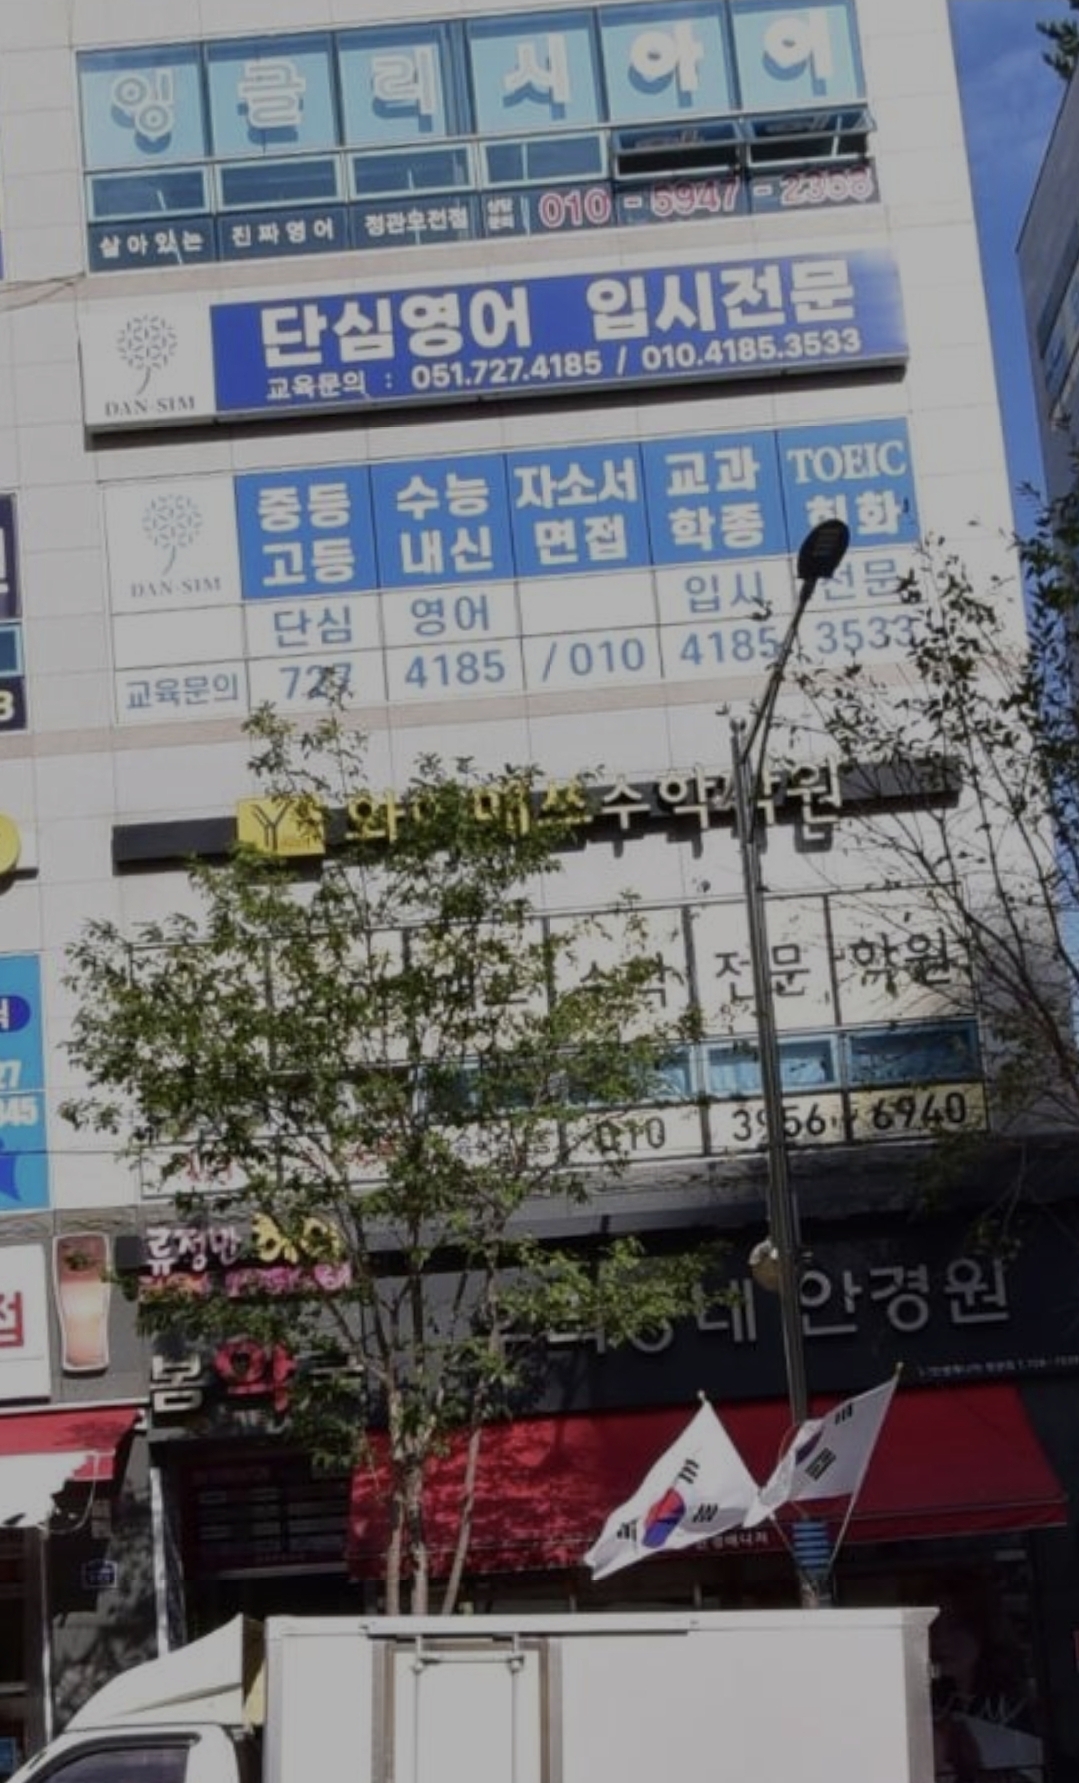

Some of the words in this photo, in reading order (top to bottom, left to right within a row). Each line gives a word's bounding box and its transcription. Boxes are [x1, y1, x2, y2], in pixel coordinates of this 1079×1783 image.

[100, 229, 203, 259] 살아있는
[231, 218, 334, 248] 진짜영어
[538, 187, 612, 228] 010
[260, 286, 532, 368] 단심영어
[586, 259, 855, 341] 입시전문
[266, 369, 367, 400] 교육문의
[410, 350, 603, 391] 051.727.4185
[641, 327, 862, 371] 010.4185.3533
[257, 482, 352, 533] 중등
[396, 473, 490, 520] 수능
[513, 457, 639, 510] 자소서
[664, 446, 759, 497] 교과
[787, 440, 907, 484] TOEIC
[262, 538, 356, 587] 고등
[401, 526, 494, 575] 내신
[533, 514, 629, 566] 면접
[668, 502, 766, 553] 학종
[273, 604, 353, 648] 단심
[410, 594, 491, 637] 영어
[684, 571, 766, 614] 입시
[125, 672, 239, 710] 교육문의
[404, 650, 507, 689] 4185
[680, 626, 781, 666] 4185
[871, 1091, 967, 1131] 6940
[801, 1256, 1011, 1338] 안경원
